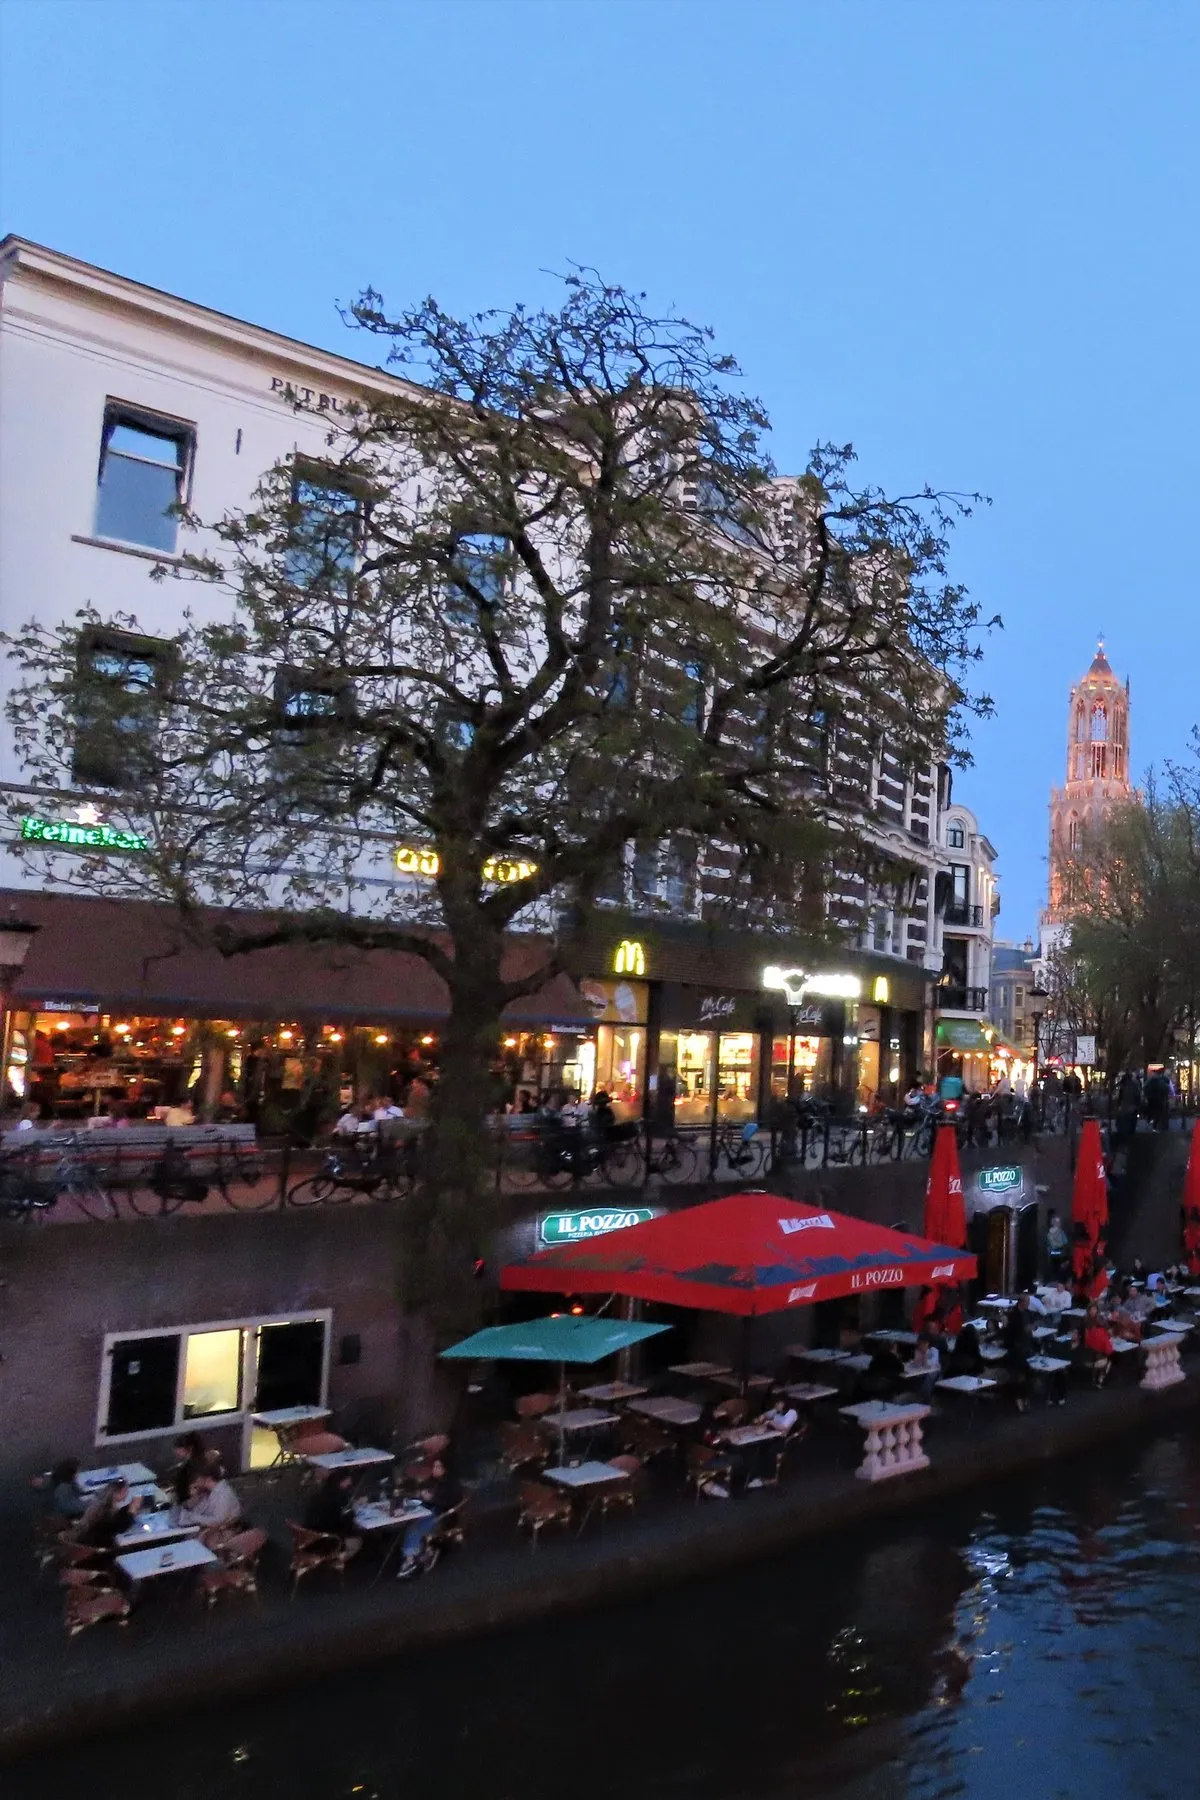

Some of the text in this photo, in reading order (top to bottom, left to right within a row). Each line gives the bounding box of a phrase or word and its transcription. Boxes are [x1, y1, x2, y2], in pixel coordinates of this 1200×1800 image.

[985, 1170, 1016, 1184] IL POZZO
[558, 1217, 578, 1233] IL
[579, 1212, 640, 1231] POZZO
[851, 1269, 903, 1288] IL POZZO
